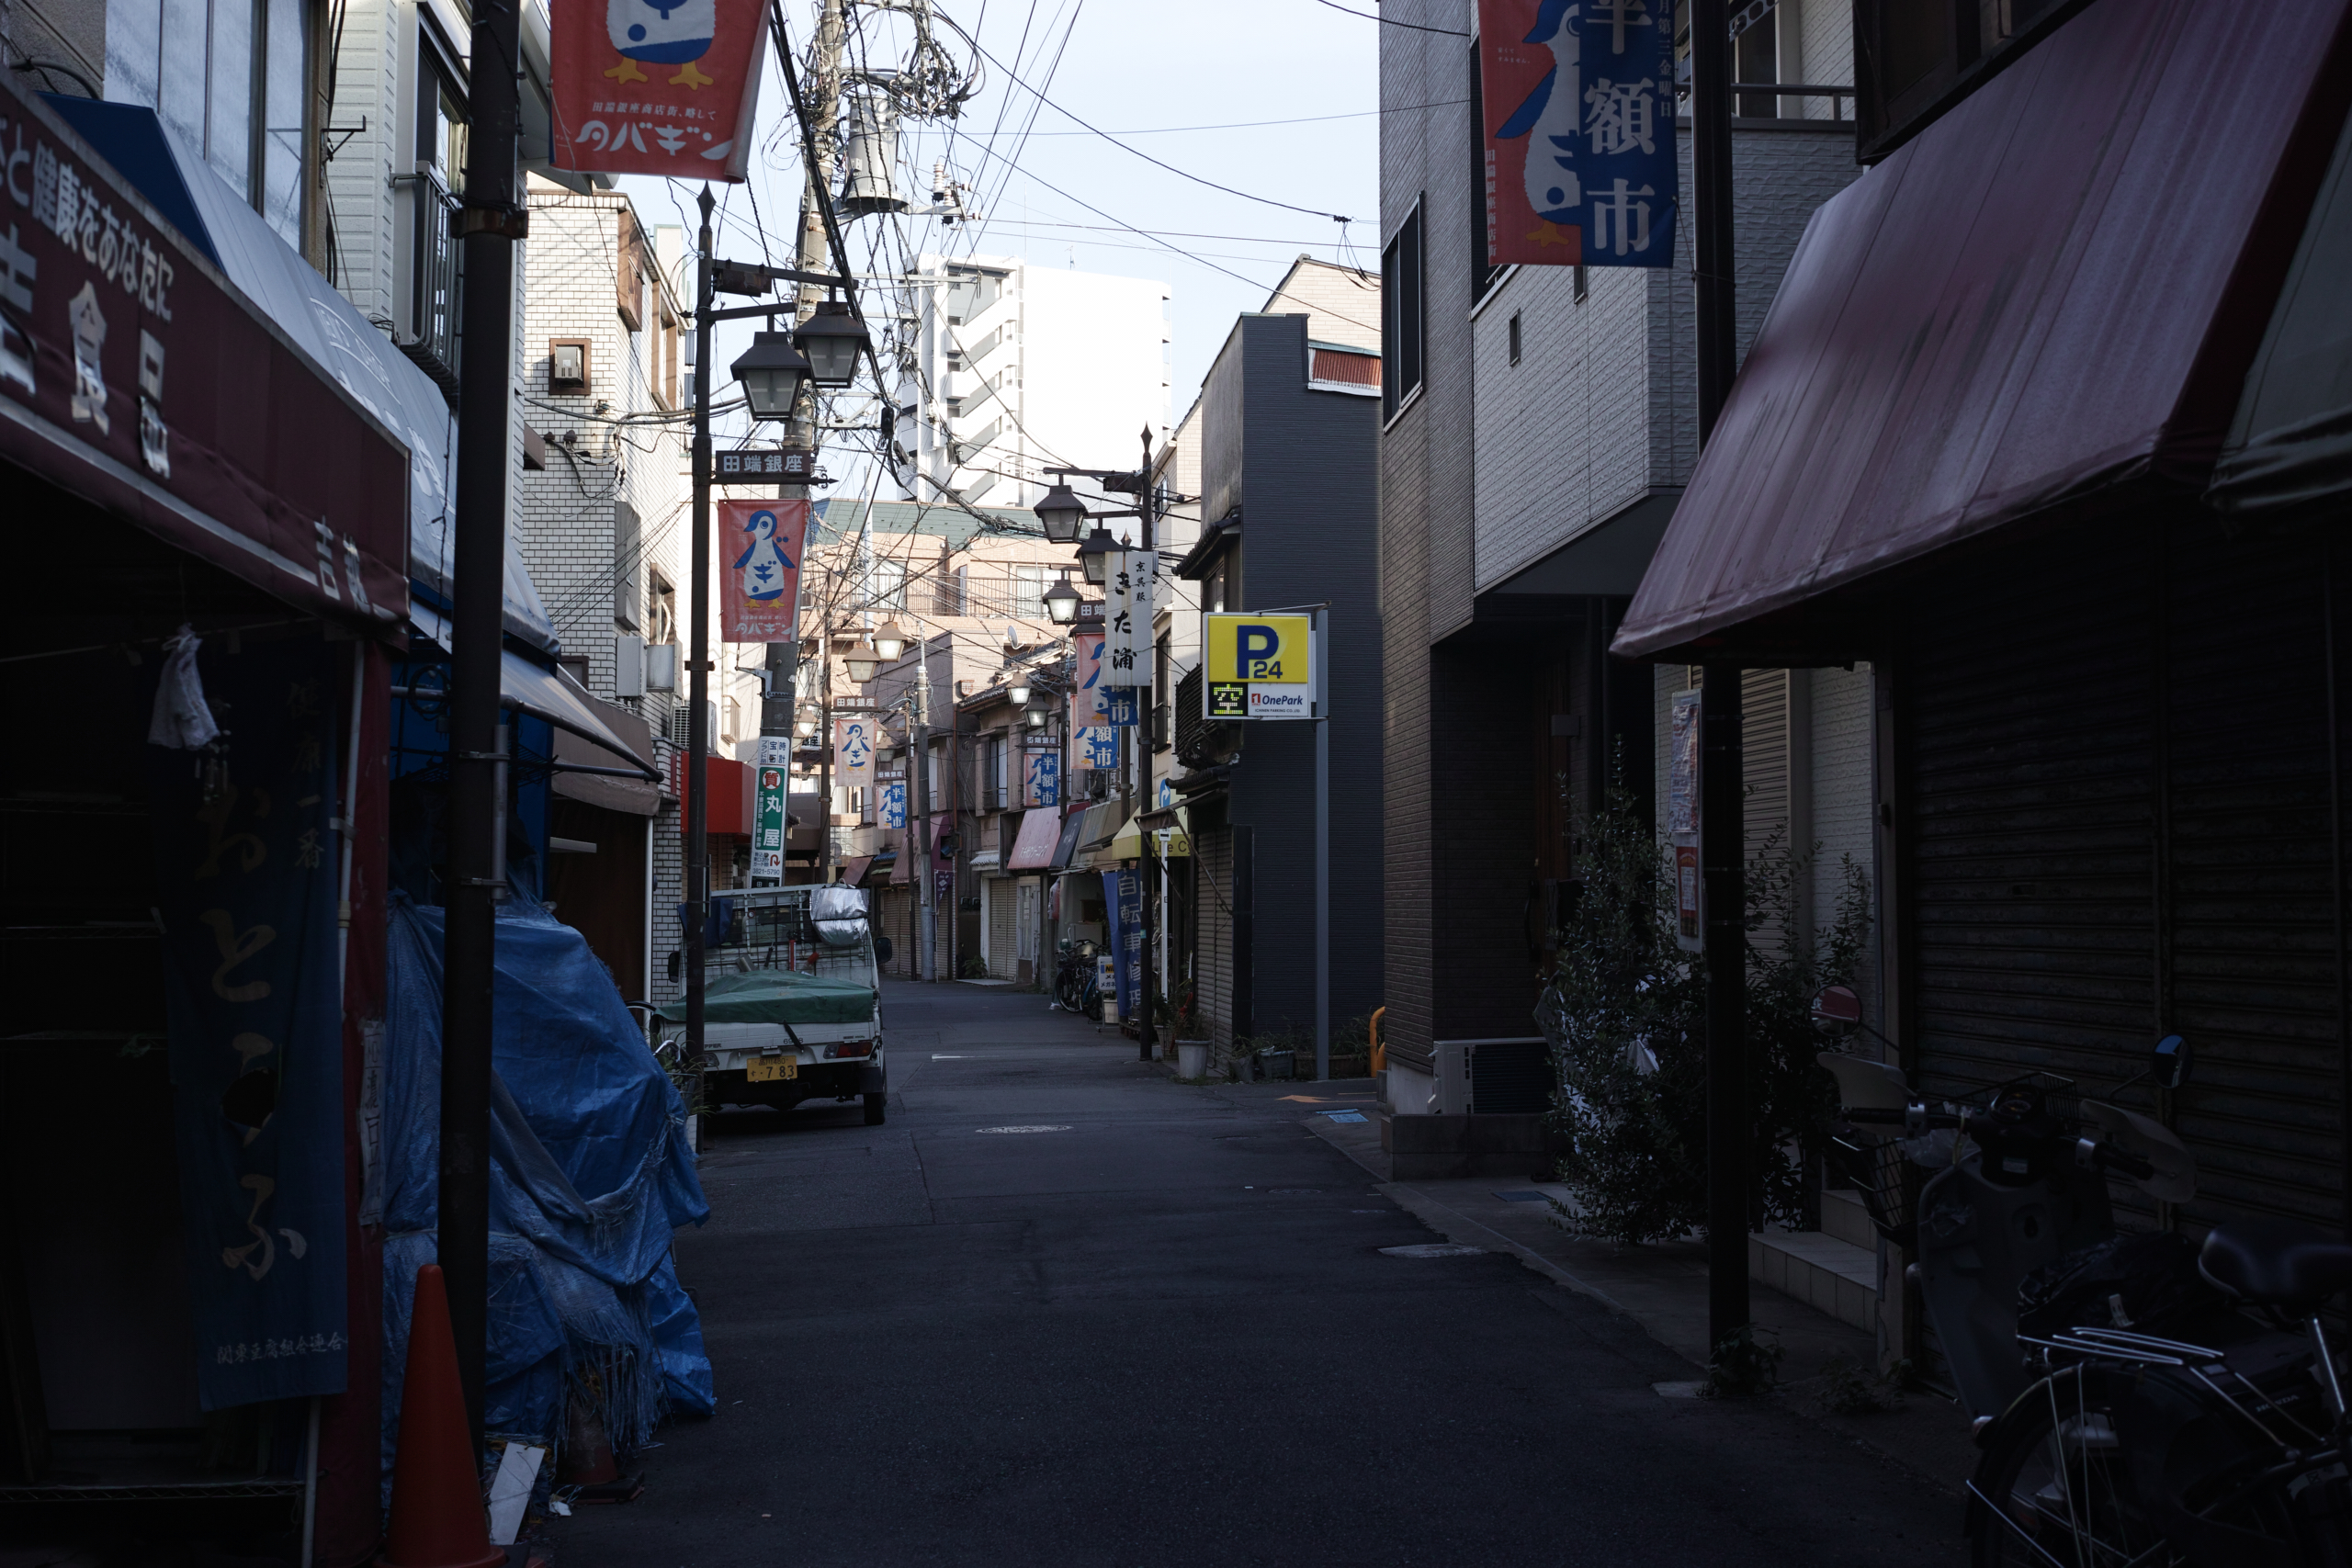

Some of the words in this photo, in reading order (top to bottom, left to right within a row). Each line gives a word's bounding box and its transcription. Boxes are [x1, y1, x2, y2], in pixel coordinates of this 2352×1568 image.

[592, 101, 717, 120] 田端銀座商店街、略して
[1585, 0, 1655, 256] 半額市
[722, 454, 804, 473] 田端銀座
[1080, 604, 1106, 616] 田端
[1112, 571, 1137, 671] きた浦
[1237, 625, 1279, 679] P
[1253, 660, 1283, 679] 24
[836, 697, 875, 707] 田端銀座
[1213, 683, 1243, 714] 空
[1261, 695, 1303, 705] OnePark
[763, 772, 779, 788] 質
[1041, 756, 1055, 805] 半額市
[891, 787, 902, 828] 半額市
[763, 795, 782, 847] 丸屋
[1152, 841, 1174, 852] Lie
[752, 867, 780, 875] 3821-5790
[1117, 874, 1141, 1009] 自転車修理
[217, 1332, 348, 1364] 関東豆腐組合連合
